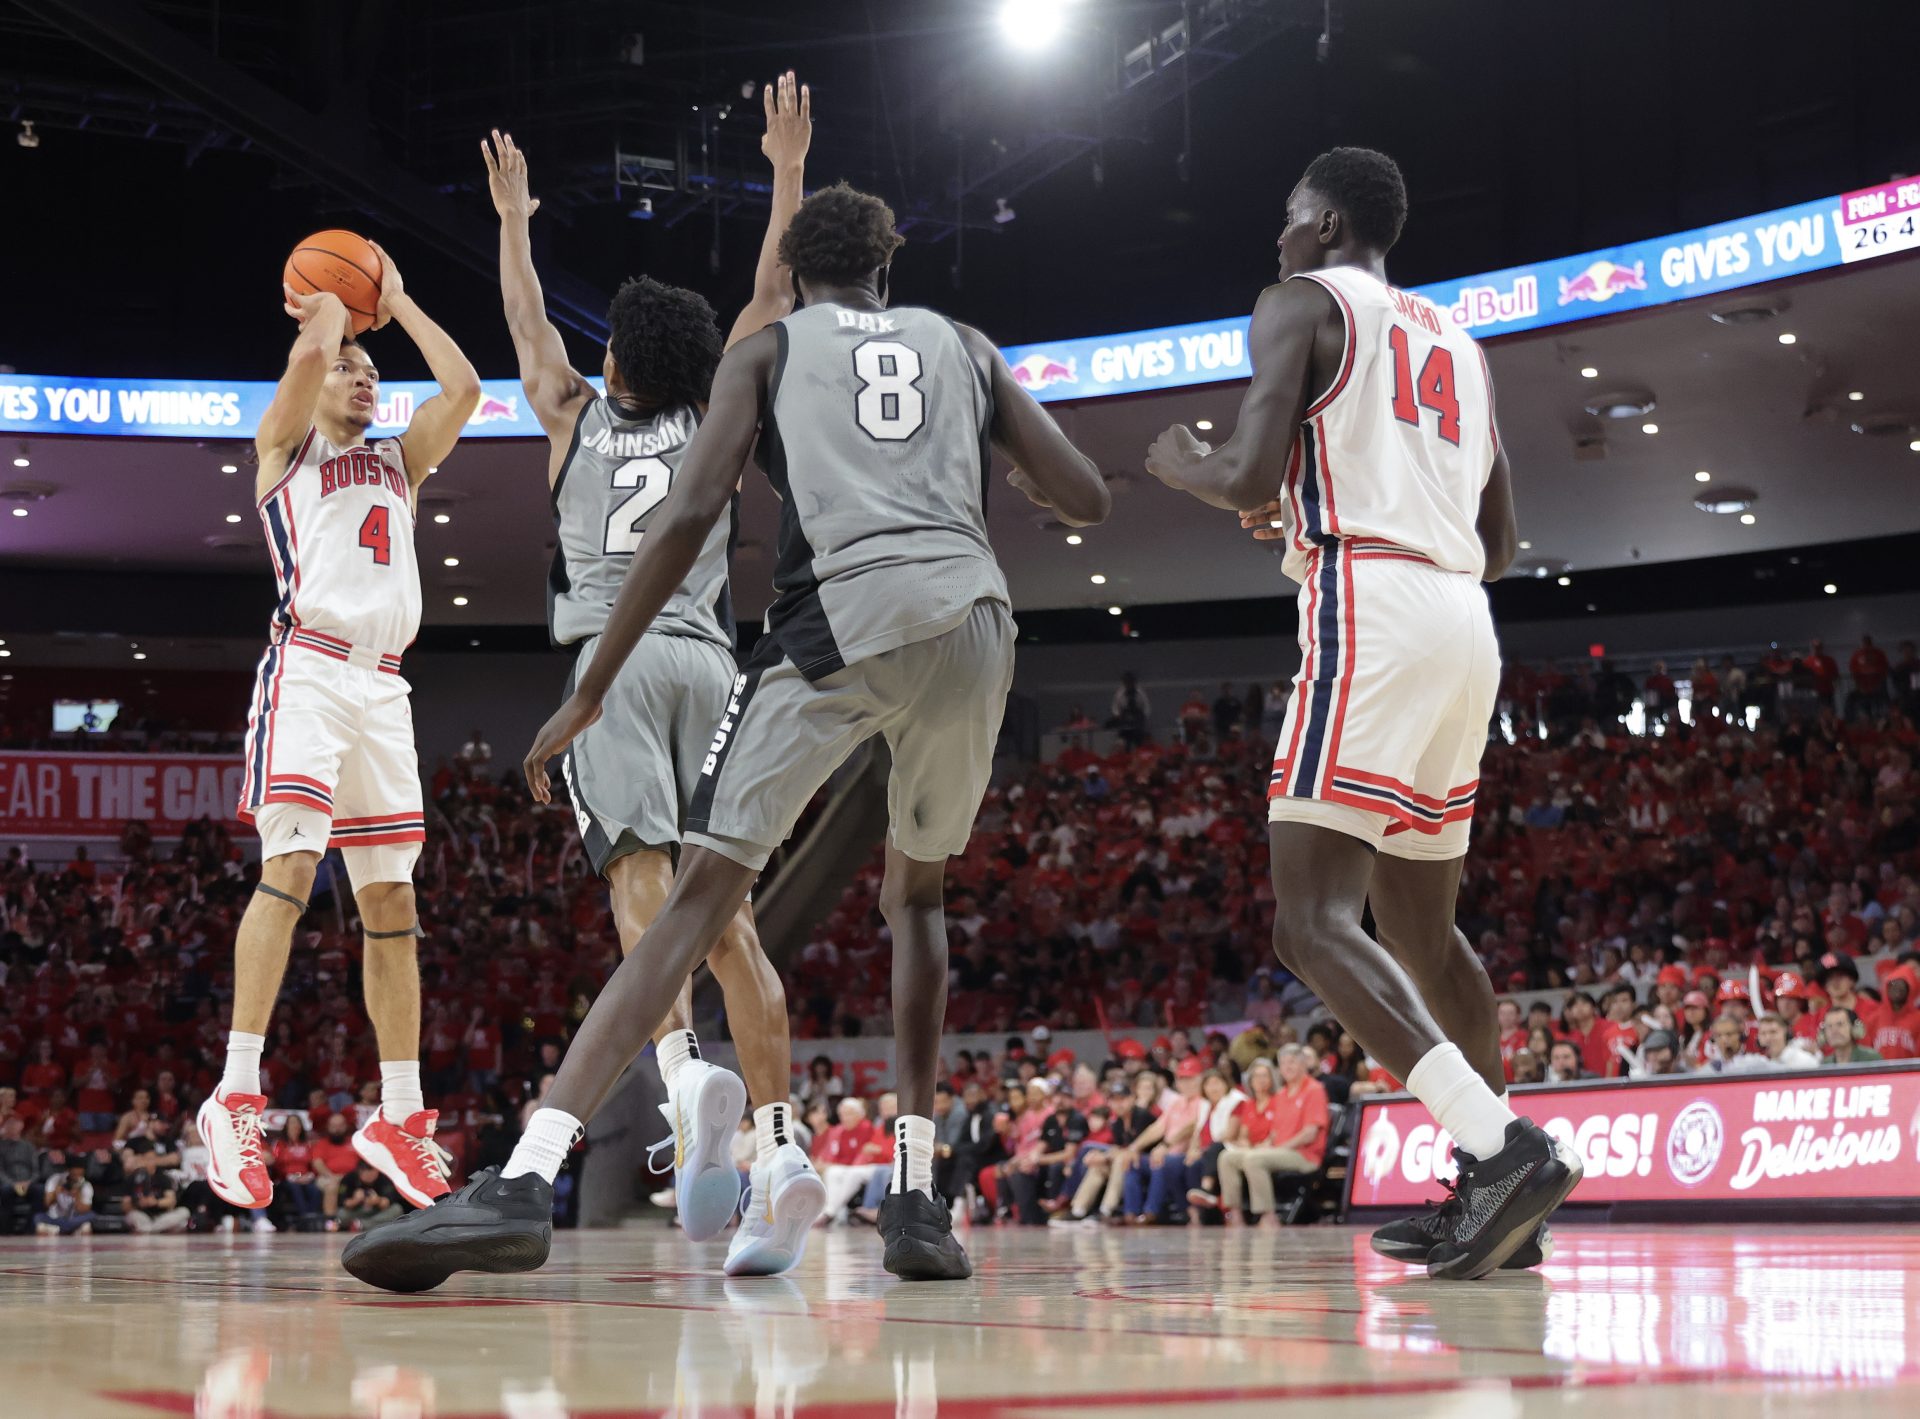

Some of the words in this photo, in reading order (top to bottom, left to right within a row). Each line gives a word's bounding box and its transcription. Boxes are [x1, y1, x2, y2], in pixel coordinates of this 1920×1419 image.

[1660, 232, 1751, 288] GIVES
[1754, 213, 1825, 267] YOU
[1385, 285, 1443, 337] SAKHO
[1091, 339, 1175, 384] GIVES
[1178, 329, 1243, 372] YOU
[1388, 322, 1461, 449] 14
[44, 387, 111, 423] YOU
[374, 394, 411, 426] ull
[851, 339, 926, 443] 8
[359, 504, 391, 567] 4
[602, 455, 674, 557] 2
[701, 672, 748, 777] BUFFS
[71, 764, 157, 820] THE
[1753, 1089, 1831, 1122] MAKE
[1833, 1084, 1892, 1118] LIFE
[1729, 1120, 1901, 1190] Delicious
